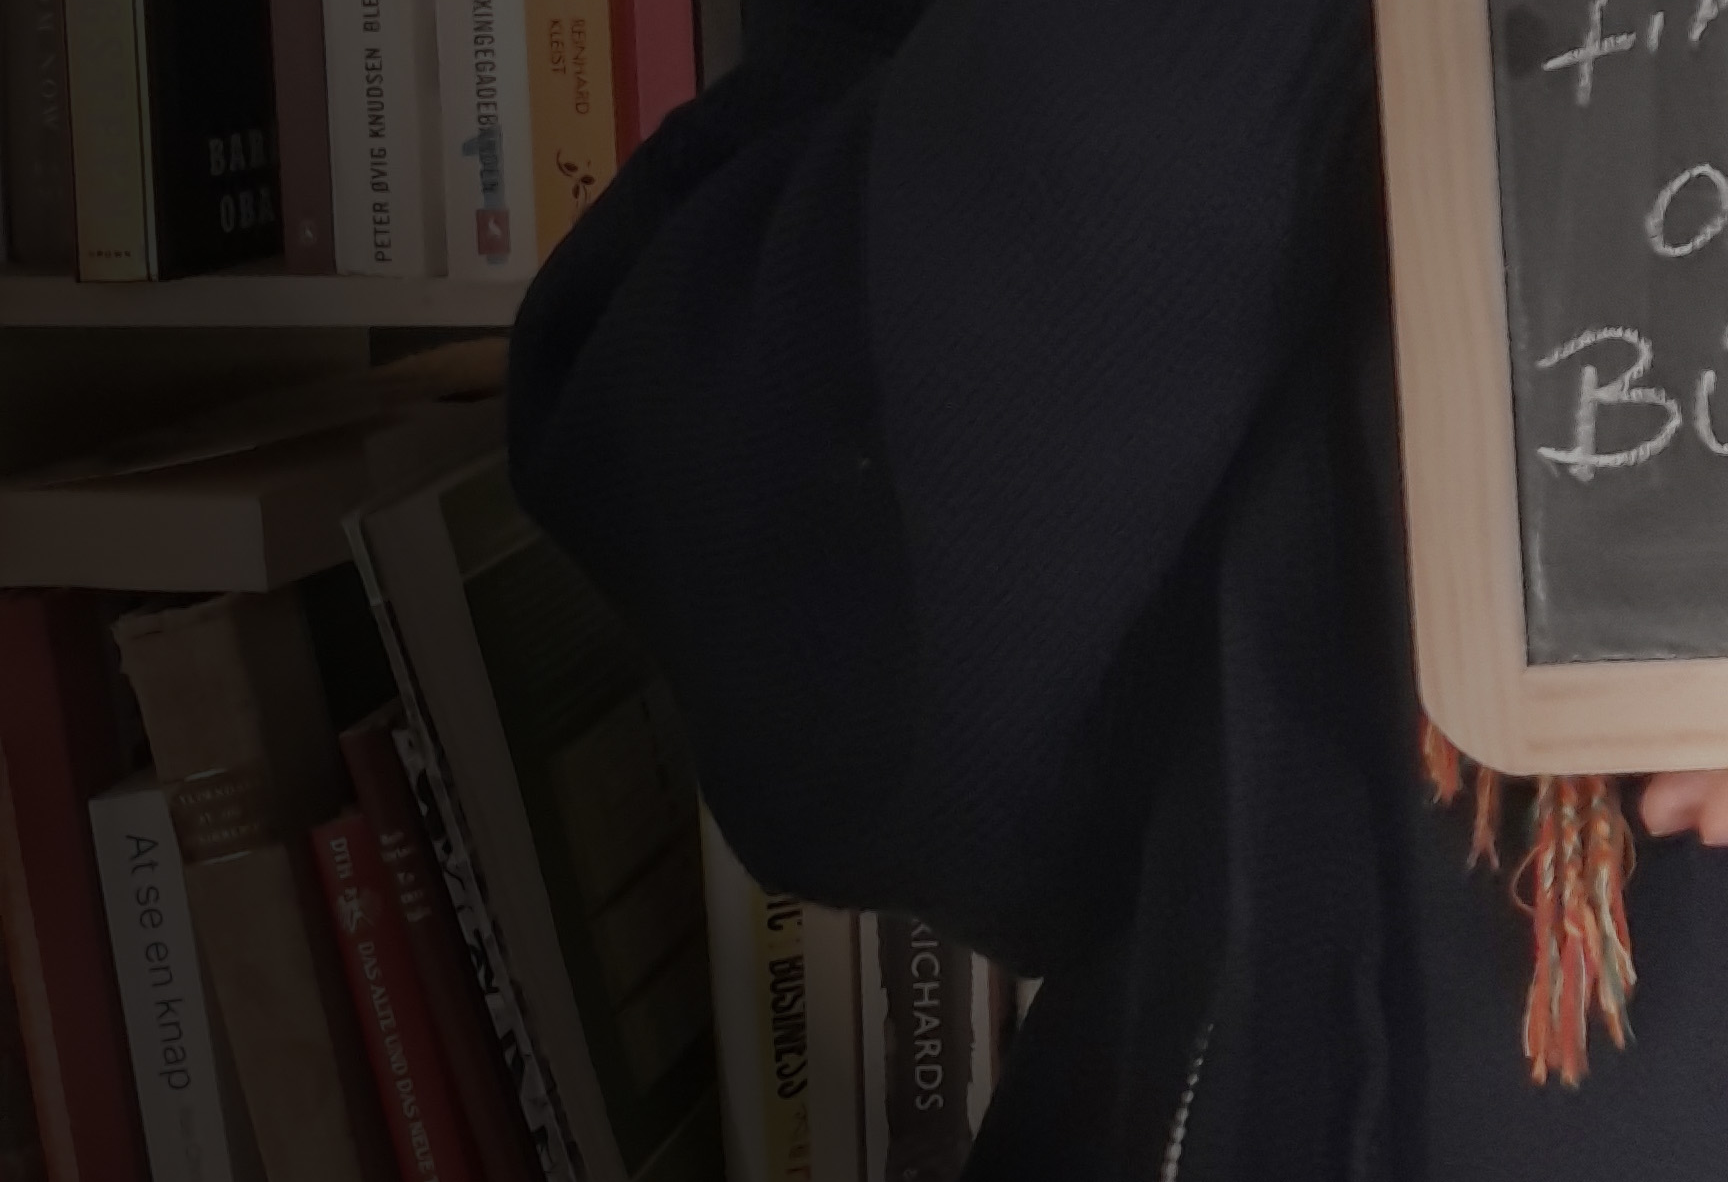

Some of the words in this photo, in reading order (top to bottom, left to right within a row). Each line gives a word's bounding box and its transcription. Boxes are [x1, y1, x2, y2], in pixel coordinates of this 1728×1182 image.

[549, 17, 567, 76] KLEIST
[363, 47, 388, 139] KNUDSEN
[369, 147, 392, 196] ØVIG
[373, 200, 393, 265] PETER
[124, 833, 160, 875] At
[135, 882, 165, 930] se
[766, 890, 804, 932] IC
[144, 940, 174, 988] en
[356, 940, 383, 992] DAS
[154, 997, 193, 1092] knap
[767, 954, 810, 1100] BUSINESS
